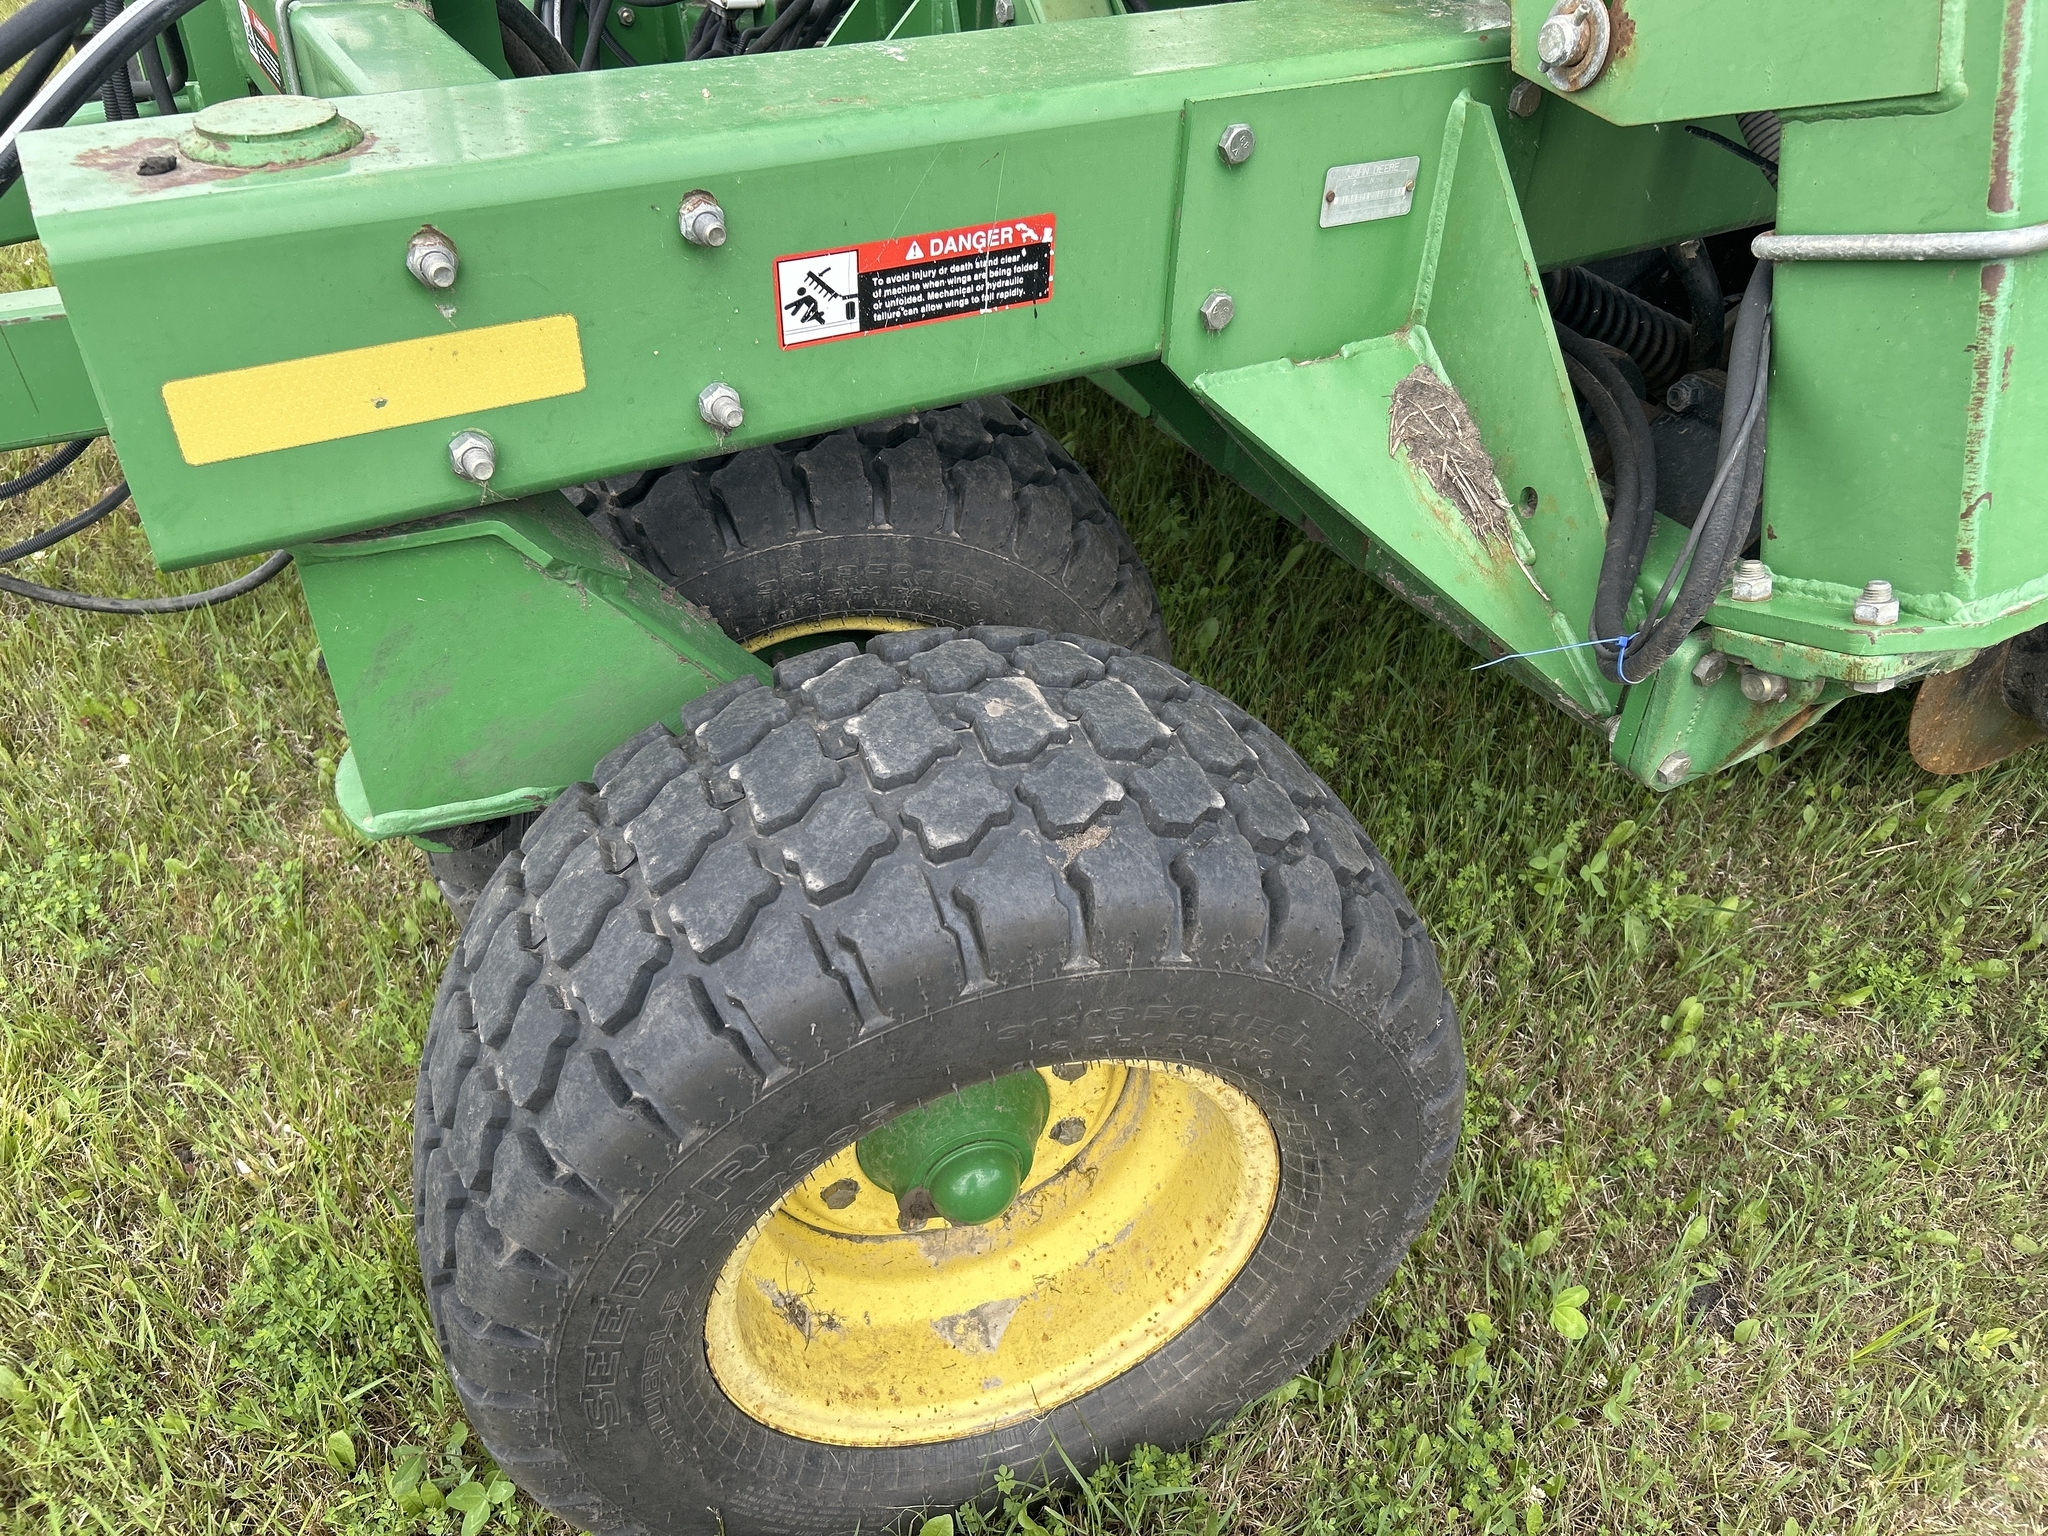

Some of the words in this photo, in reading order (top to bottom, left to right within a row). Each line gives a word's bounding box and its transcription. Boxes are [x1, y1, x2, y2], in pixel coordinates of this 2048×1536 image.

[1373, 162, 1400, 175] DEERE
[930, 226, 1013, 257] DANGER
[872, 277, 884, 287] To
[886, 272, 910, 285] avoid
[912, 269, 936, 281] injury
[939, 266, 948, 275] or
[950, 261, 973, 273] death
[975, 257, 998, 269] stand
[1000, 254, 1021, 265] clear
[872, 289, 882, 298] of
[884, 283, 920, 298] machine
[922, 278, 945, 290] when
[947, 275, 971, 287] wings
[974, 271, 987, 281] are
[989, 267, 1012, 278] being
[1013, 261, 1039, 273] folded
[873, 300, 882, 310] or
[885, 294, 925, 308] unfolded.
[927, 284, 973, 301] Mechanical
[976, 283, 985, 292] or
[987, 276, 1024, 291] hydraulic
[873, 310, 901, 322] failure
[903, 307, 919, 317] can
[921, 301, 943, 313] allow
[945, 297, 970, 309] wings
[971, 295, 980, 304] to
[982, 291, 994, 302] fall
[996, 286, 1026, 301] rapidly.
[582, 1143, 769, 1430] SEEDER
[641, 1284, 690, 1464] STUBBLE
